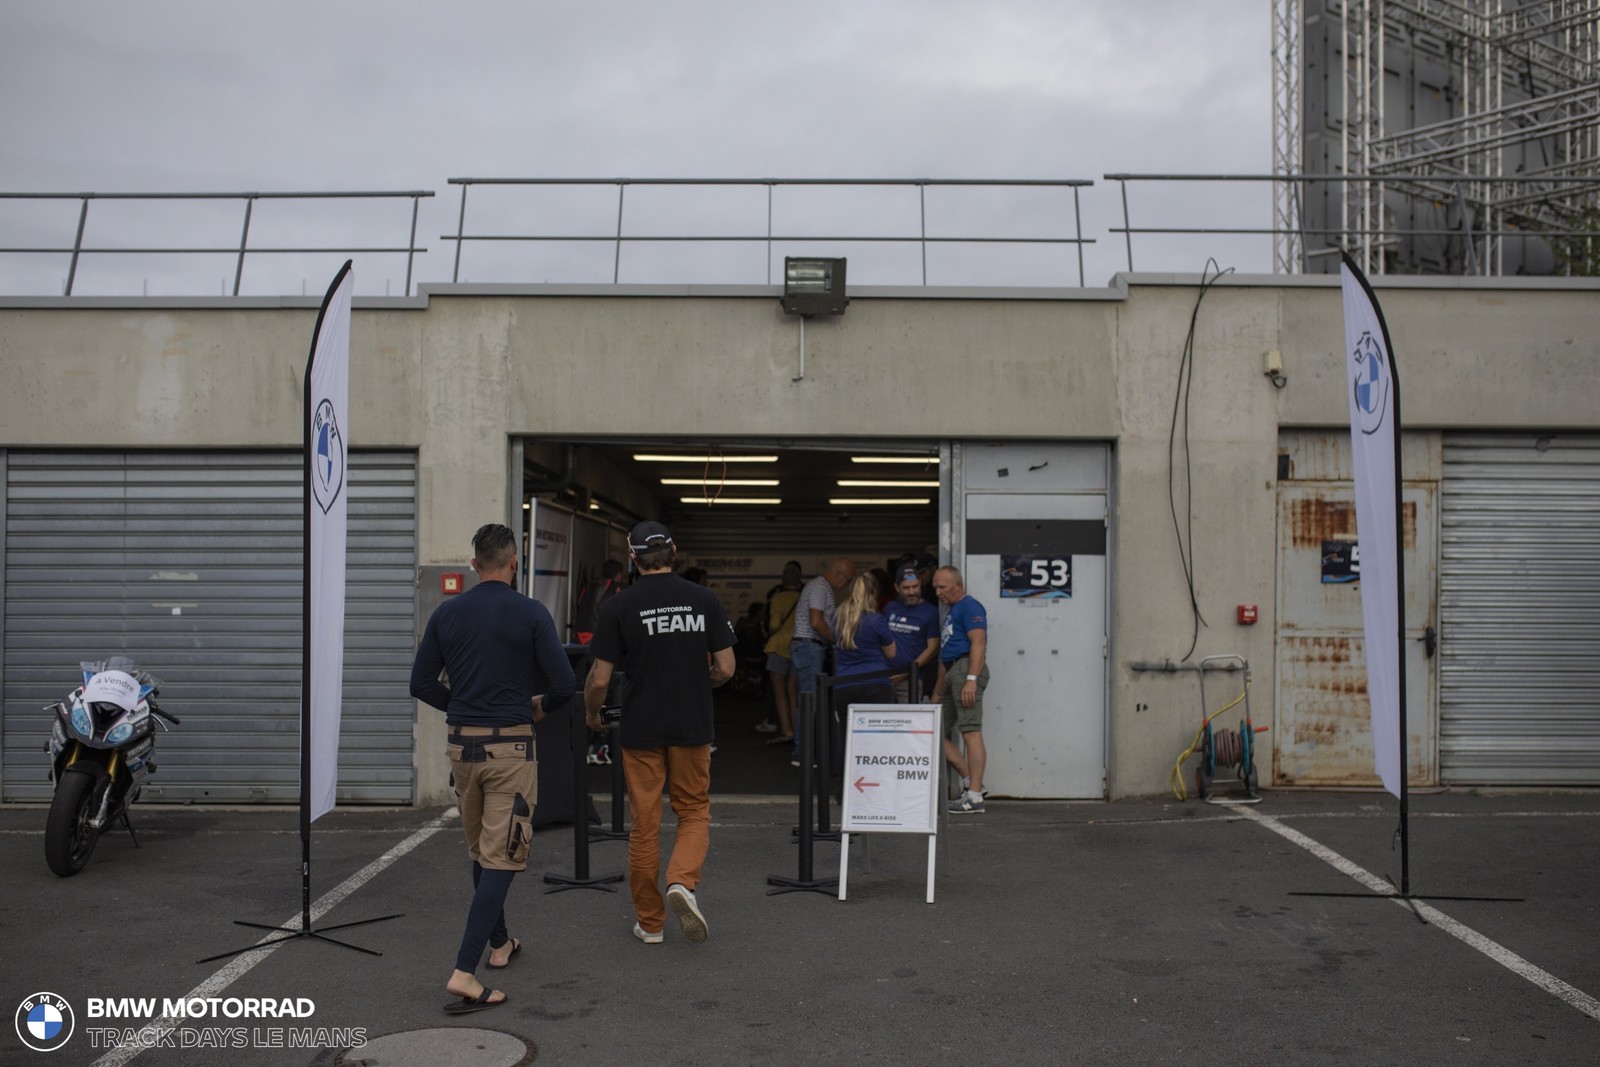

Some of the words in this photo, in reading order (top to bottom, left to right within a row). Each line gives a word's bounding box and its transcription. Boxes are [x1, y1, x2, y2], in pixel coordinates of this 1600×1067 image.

[1030, 559, 1069, 587] 53
[640, 609, 656, 617] BMW
[657, 605, 692, 614] MOTORRAD
[642, 614, 706, 636] TEAM
[104, 676, 135, 692] Vendre
[855, 755, 929, 766] TRACKDAYS
[897, 770, 929, 781] BMW
